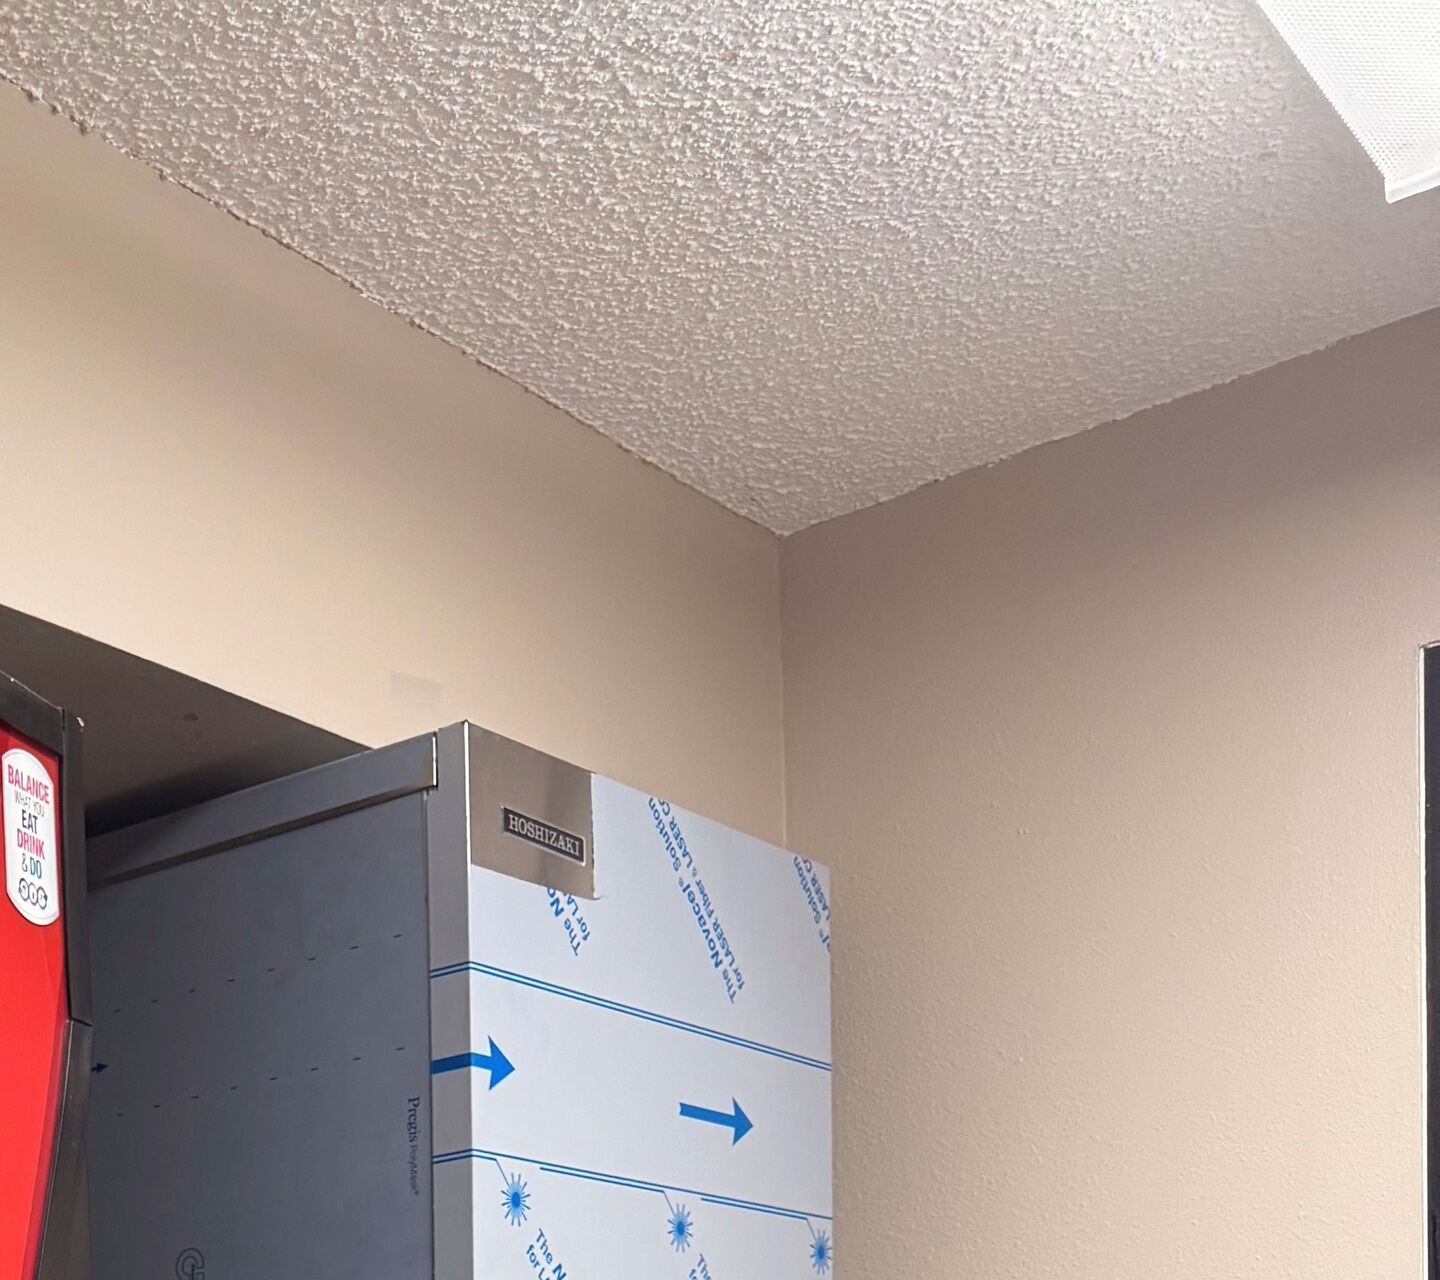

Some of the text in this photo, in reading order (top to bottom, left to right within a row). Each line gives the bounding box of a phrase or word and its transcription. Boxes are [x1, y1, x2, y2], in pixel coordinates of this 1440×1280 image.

[8, 764, 50, 805] BALANCE
[14, 789, 31, 809] WHAT
[22, 809, 38, 834] EAT
[508, 814, 580, 857] HOSHIZAKI
[17, 828, 45, 860] DRINK
[669, 815, 693, 869] LASER
[30, 856, 42, 879] DO
[564, 918, 580, 956] The
[576, 917, 590, 941] for
[712, 917, 735, 967] LASER
[722, 968, 736, 1004] The
[733, 967, 745, 990] for
[407, 1096, 421, 1143] Pregis
[526, 1244, 540, 1268] for
[536, 1227, 553, 1264] The
